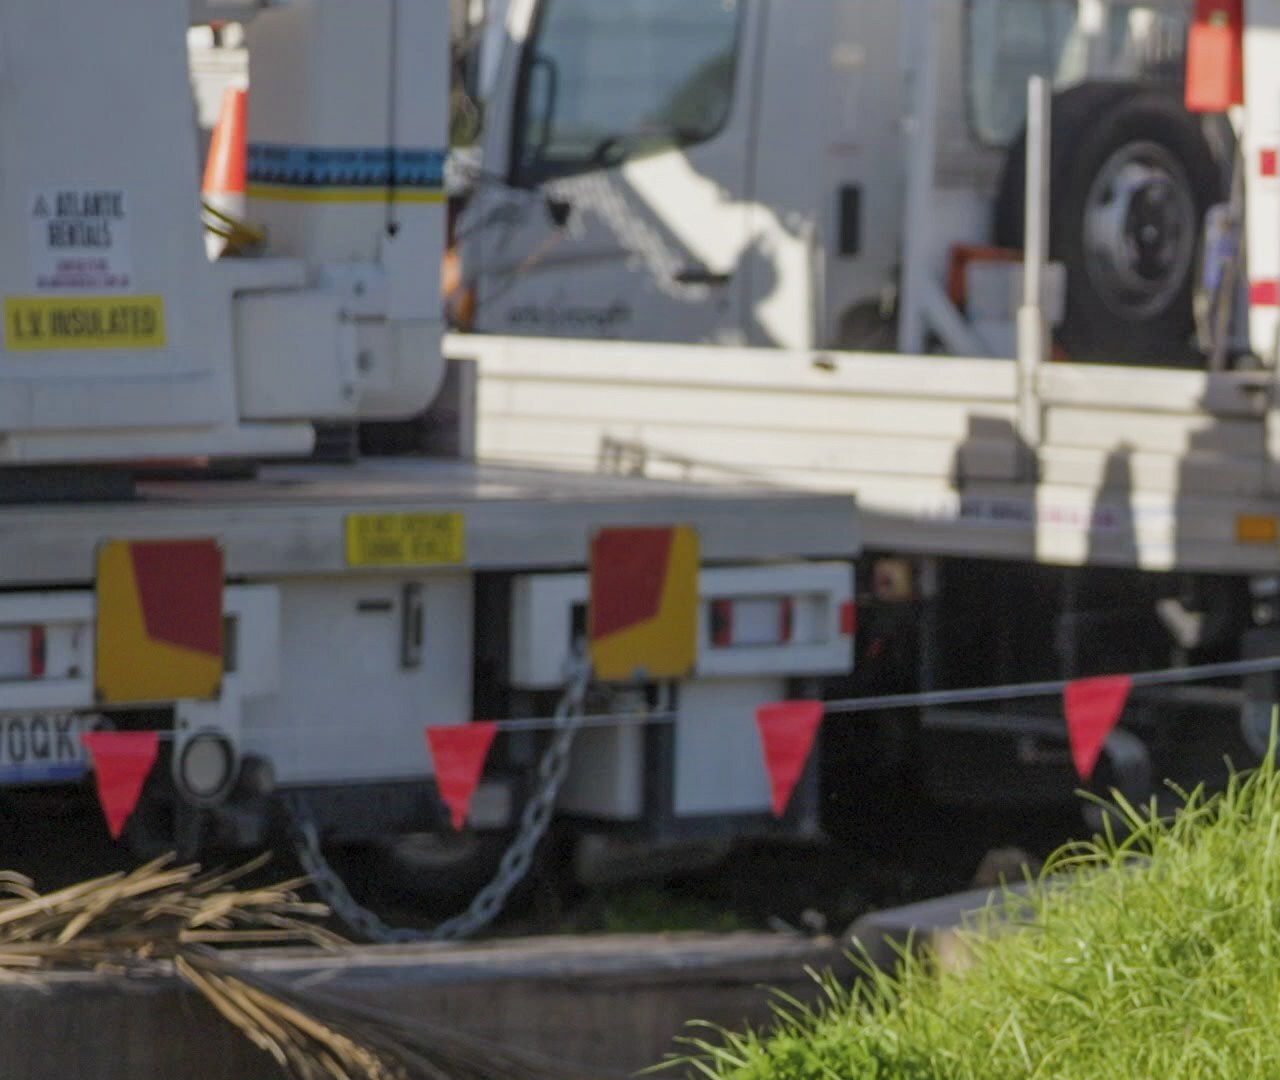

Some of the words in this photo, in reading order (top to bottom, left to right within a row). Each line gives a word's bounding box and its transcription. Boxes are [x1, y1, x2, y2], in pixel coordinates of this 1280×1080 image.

[55, 189, 125, 217] ATLANTIC
[47, 221, 112, 247] RENTALS
[50, 305, 157, 338] INSULATED
